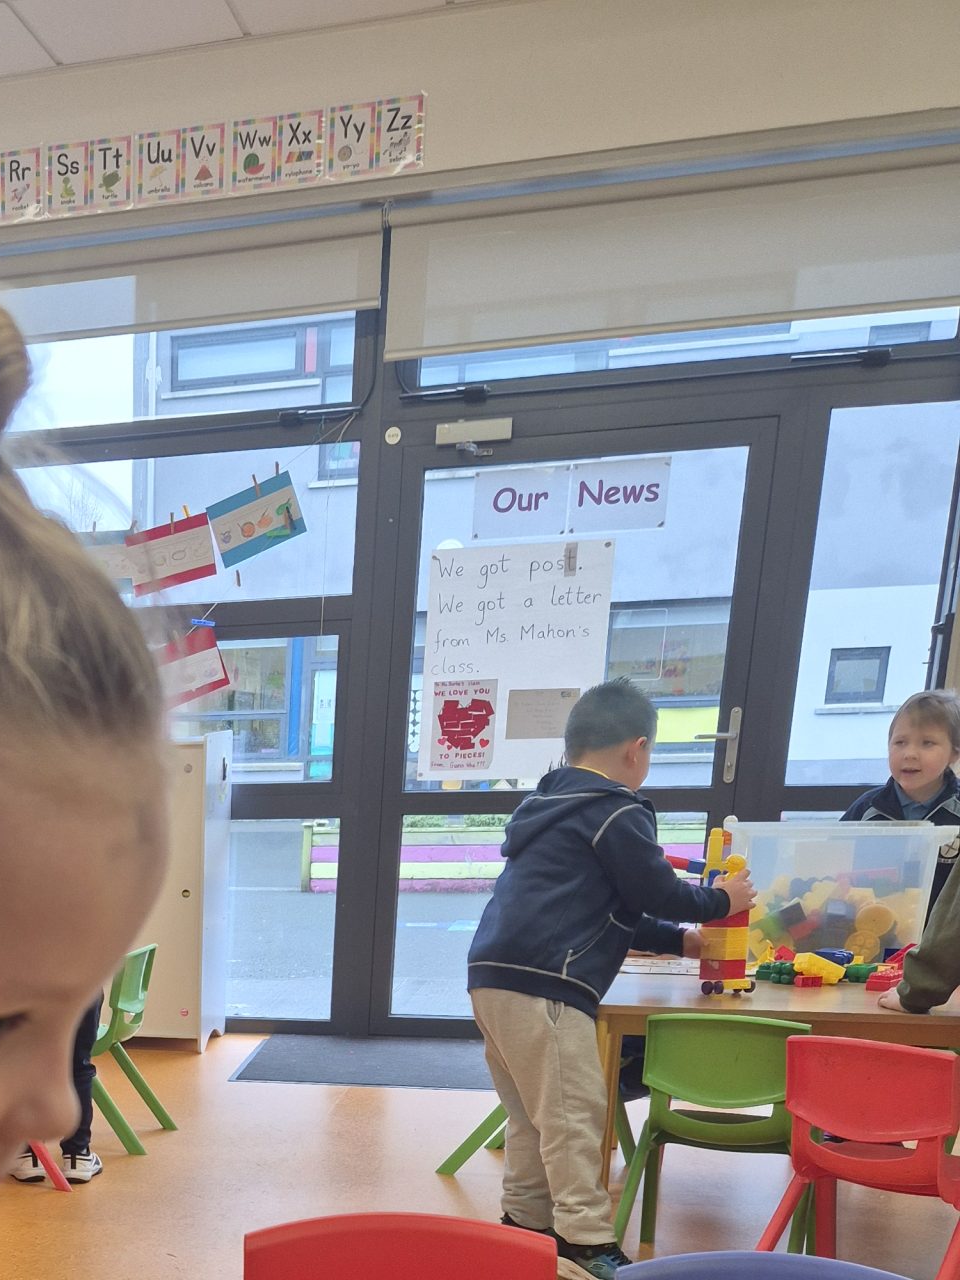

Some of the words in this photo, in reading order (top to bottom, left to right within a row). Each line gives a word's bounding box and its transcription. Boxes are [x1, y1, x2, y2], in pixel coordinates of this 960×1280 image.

[340, 114, 366, 143] Yy
[386, 107, 412, 133] Zz
[190, 134, 216, 159] Vv
[239, 129, 272, 150] Ww
[288, 121, 312, 147] Xx
[57, 153, 79, 176] Ss
[98, 147, 123, 170] Tt
[147, 141, 173, 165] Uu
[9, 159, 31, 183] Rr
[492, 487, 549, 513] Our
[578, 479, 660, 507] News
[437, 557, 464, 578] We
[477, 554, 511, 589] got
[529, 549, 583, 581] post.
[439, 592, 464, 614] We
[475, 592, 505, 626] got
[524, 597, 534, 608] a
[551, 584, 602, 606] letter
[434, 629, 470, 654] from
[521, 623, 590, 641] Mahon's
[431, 656, 480, 676] class.
